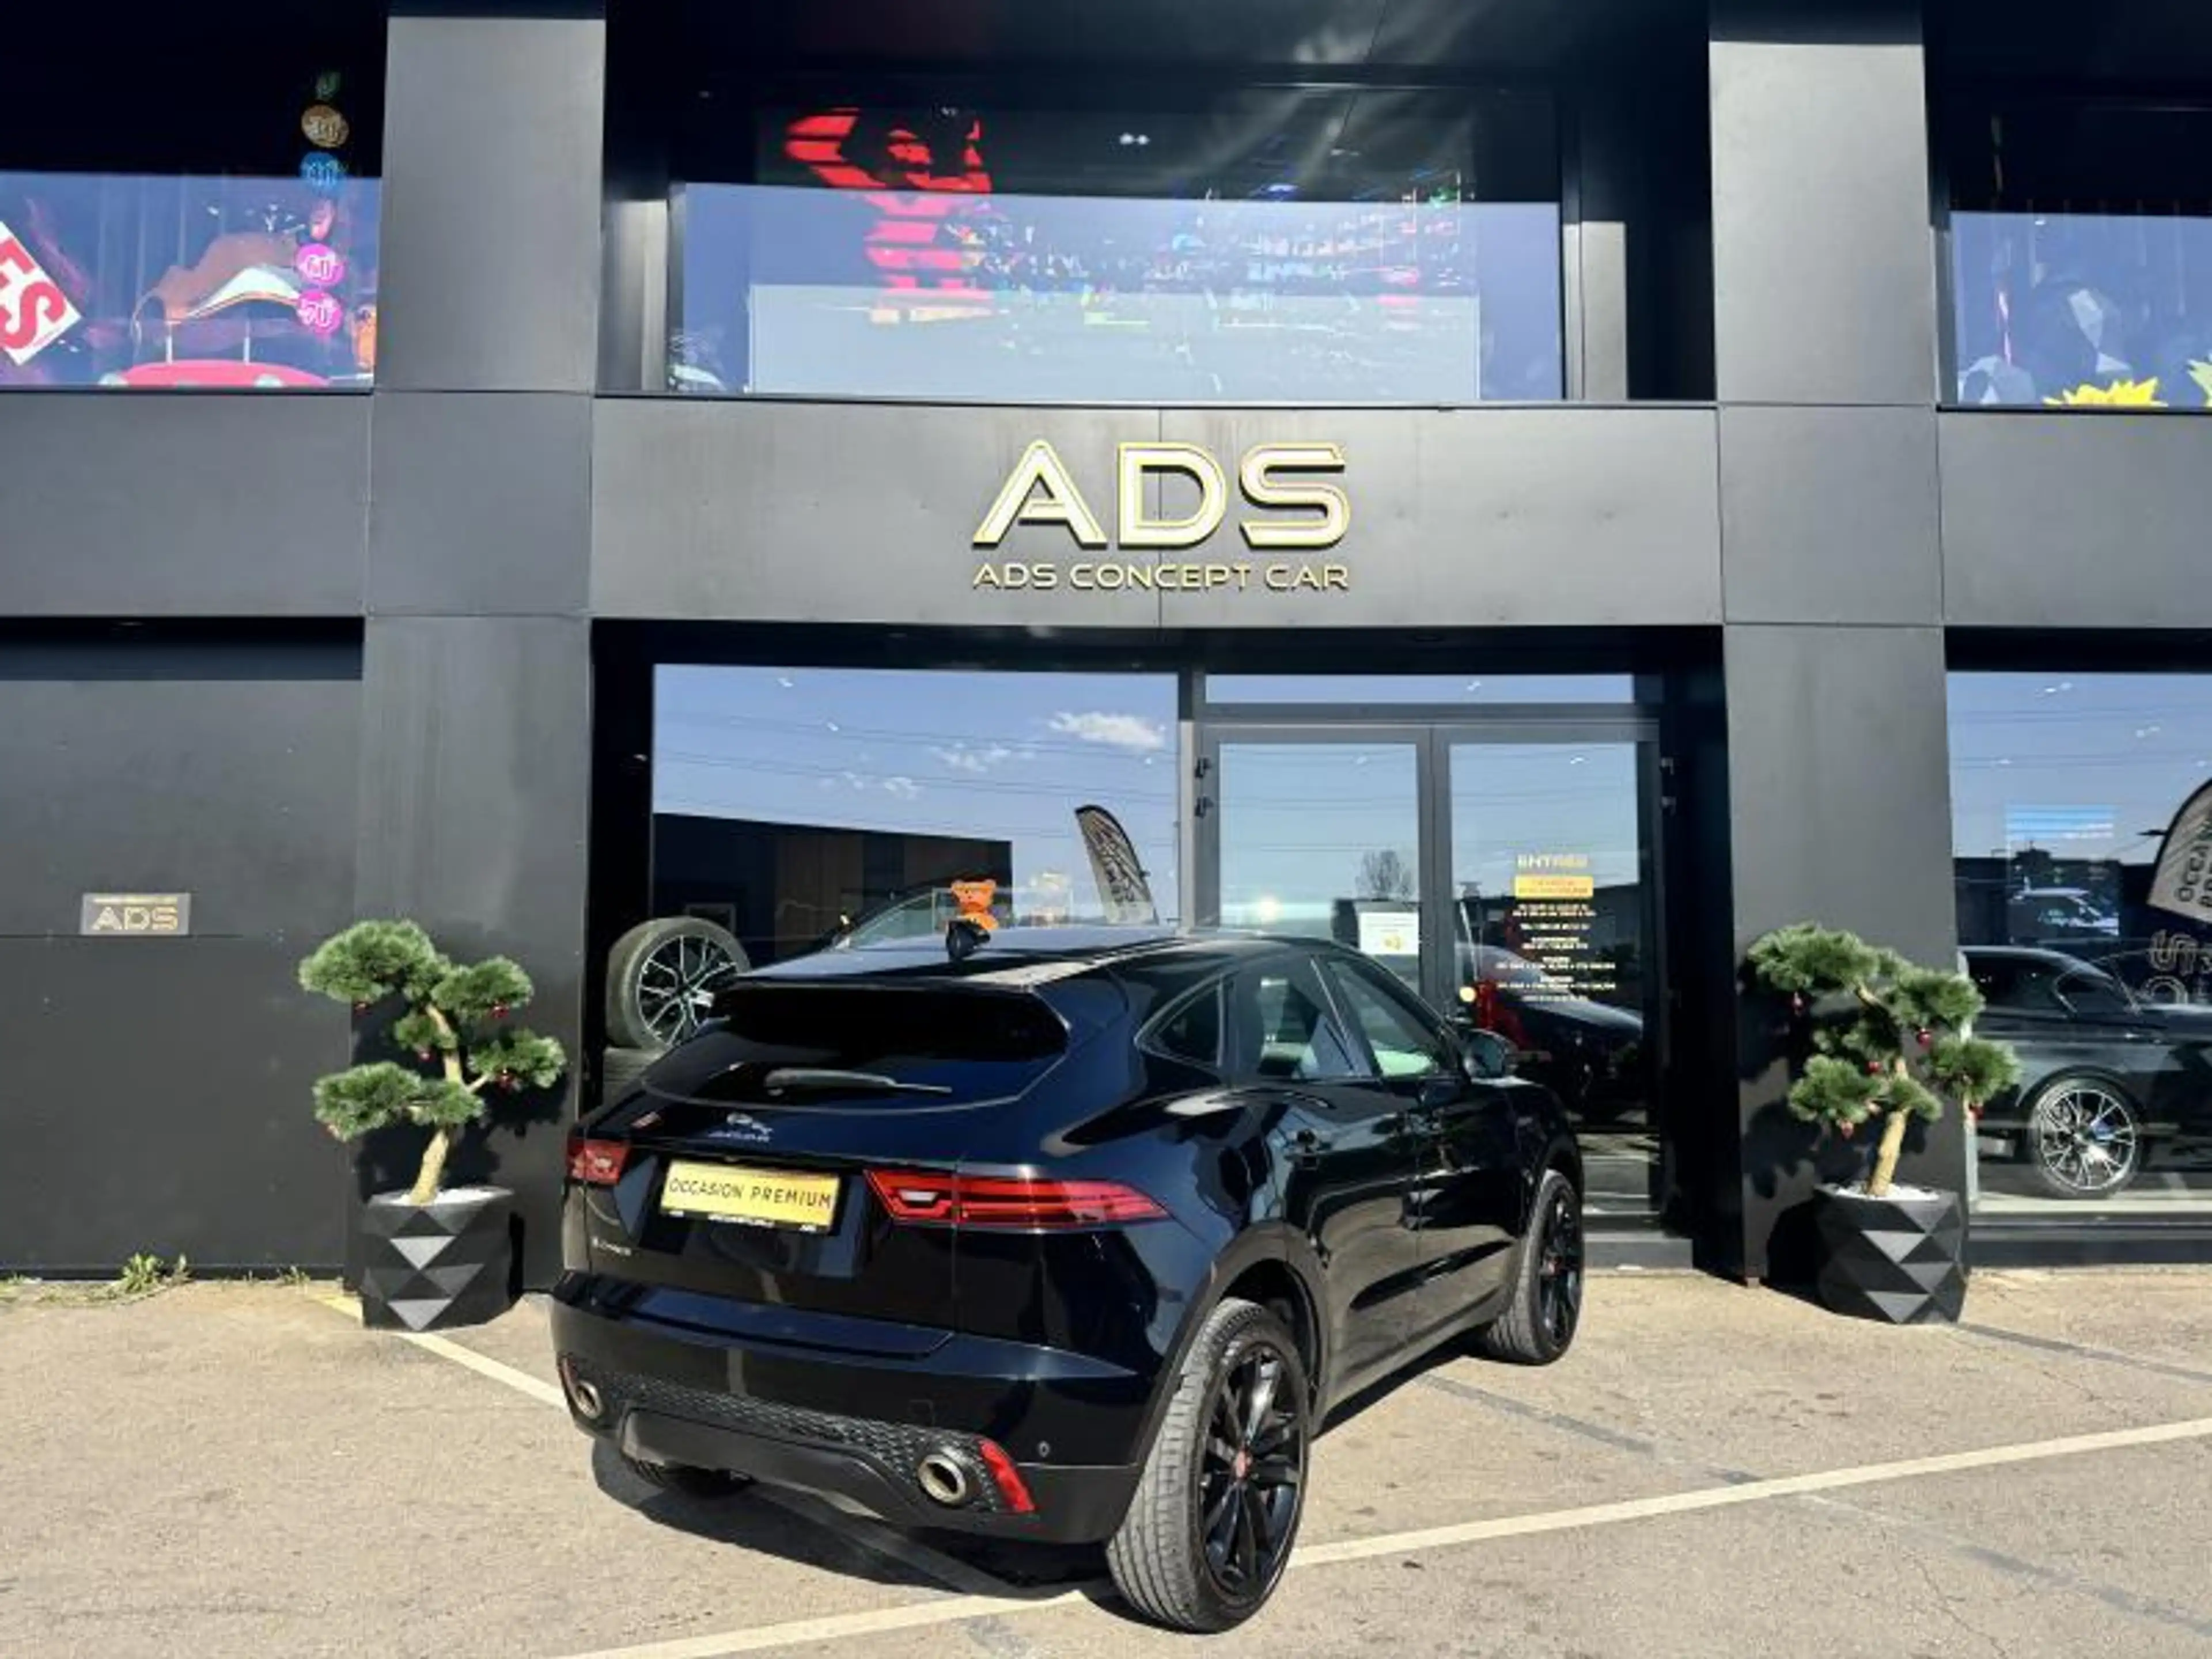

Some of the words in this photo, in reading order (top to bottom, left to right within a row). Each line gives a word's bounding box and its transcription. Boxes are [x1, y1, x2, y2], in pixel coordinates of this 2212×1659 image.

[972, 439, 1351, 550] ADS
[973, 562, 1059, 590] ADS
[1069, 562, 1251, 592] CONCEPT
[1264, 565, 1351, 592] CAR
[92, 906, 178, 930] ADS
[669, 1177, 744, 1199] OCCASION
[751, 1184, 832, 1209] PREMIUM
